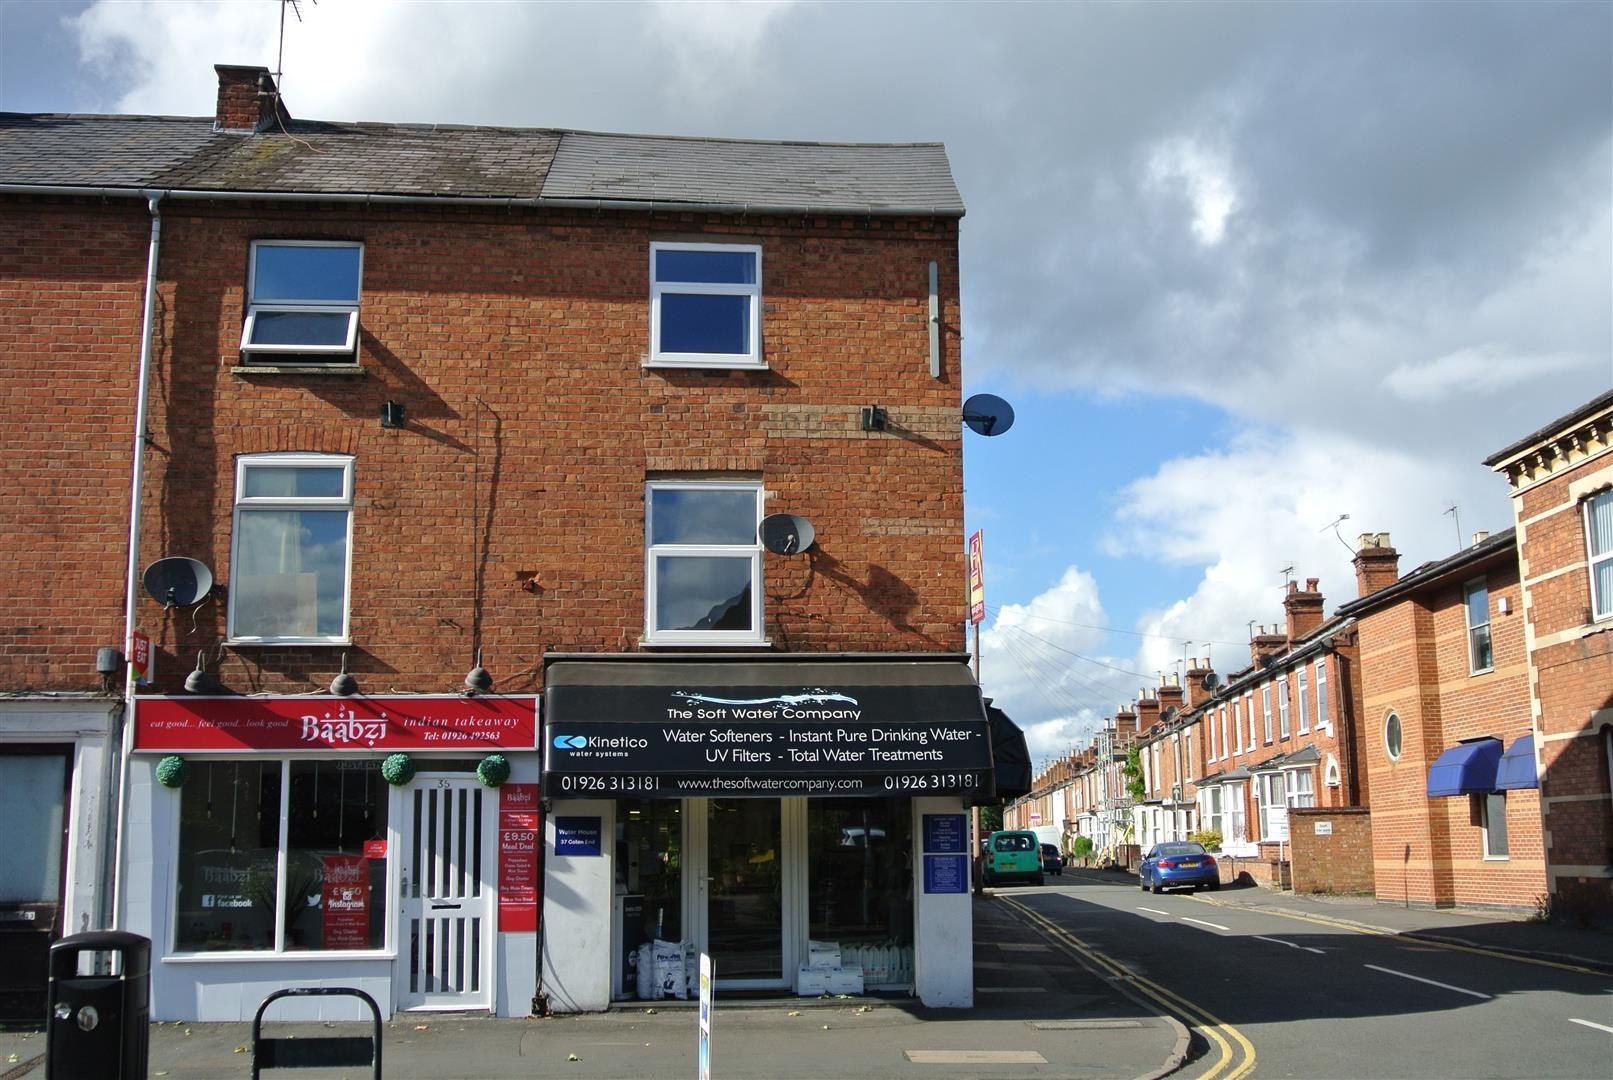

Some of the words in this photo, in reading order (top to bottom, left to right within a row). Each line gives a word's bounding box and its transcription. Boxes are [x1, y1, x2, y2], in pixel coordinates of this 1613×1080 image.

[667, 708, 692, 719] The
[697, 708, 727, 719] Soft
[732, 708, 778, 719] Water
[782, 708, 862, 721] Company
[150, 720, 164, 728] eat
[198, 719, 215, 730] feel
[266, 719, 289, 729] good
[403, 716, 448, 727] indian
[454, 716, 520, 729] takeaway
[424, 731, 440, 741] Tel:
[441, 731, 468, 741] 01926
[588, 735, 648, 748] Kinetico
[662, 728, 706, 743] Water
[709, 728, 773, 743] Softeners
[789, 728, 833, 743] Instant
[836, 728, 868, 742] Pure
[871, 728, 928, 744] Drinking
[930, 726, 972, 741] Water
[705, 749, 728, 762] UV
[732, 749, 771, 762] Filters
[787, 748, 820, 762] Total
[822, 748, 865, 762] Water
[868, 747, 943, 761] Treatments
[437, 779, 451, 789] 35
[561, 776, 606, 790] 01926
[609, 776, 660, 790] 313181
[677, 777, 863, 792] www.thesoftwatercompany.com
[884, 775, 928, 790] 01926
[930, 773, 979, 788] 313181
[217, 899, 253, 908] facebook
